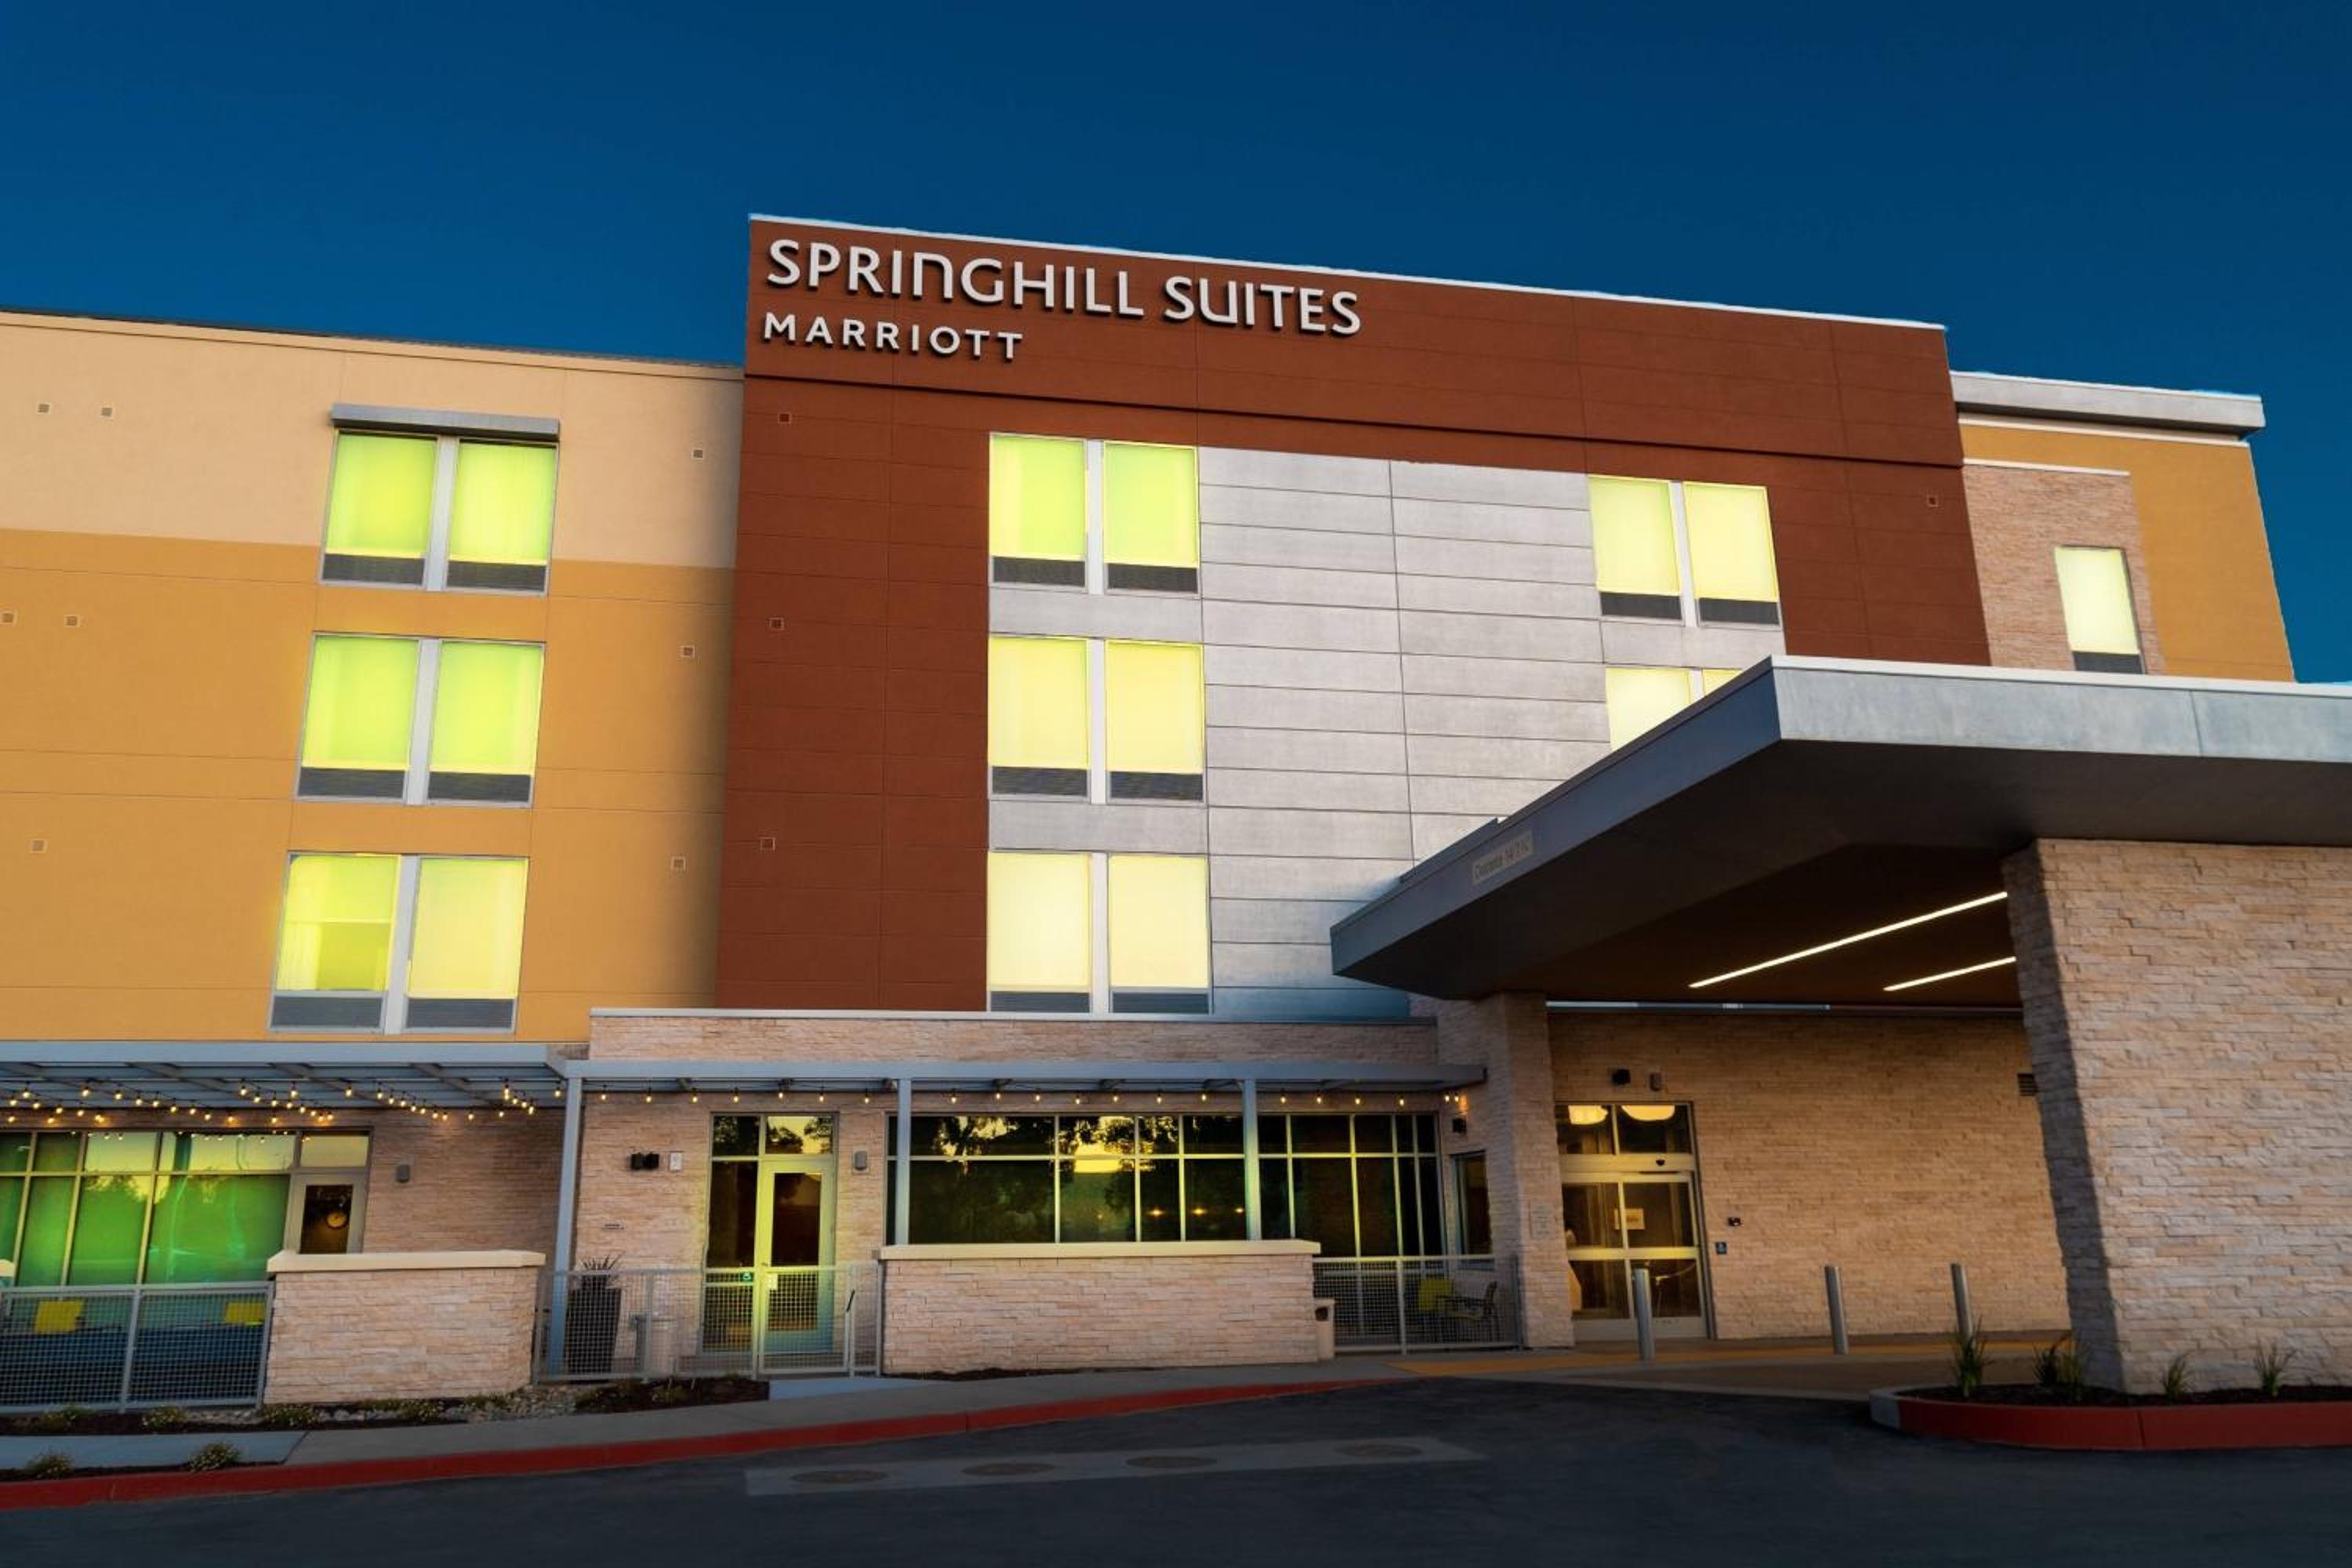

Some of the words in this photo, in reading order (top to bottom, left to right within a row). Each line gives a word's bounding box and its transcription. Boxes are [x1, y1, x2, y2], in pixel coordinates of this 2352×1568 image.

[768, 238, 1145, 315] SPRINGHILL
[1164, 274, 1361, 335] SUITES
[764, 311, 1024, 359] MARRIOTT
